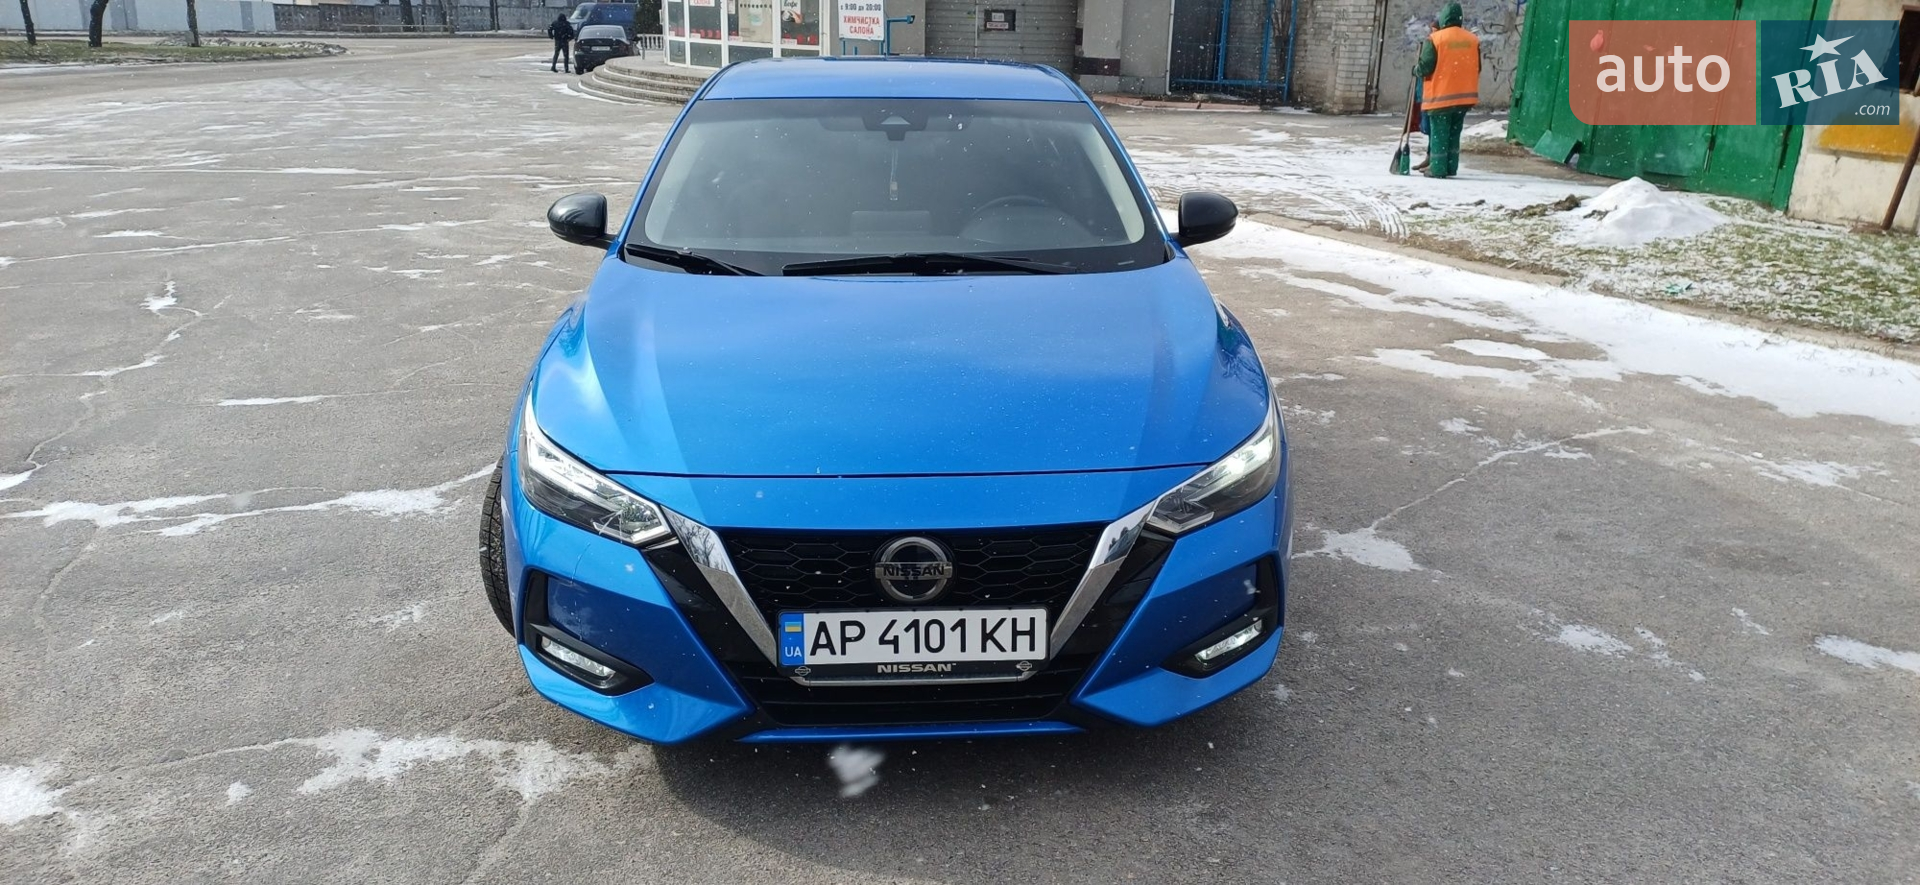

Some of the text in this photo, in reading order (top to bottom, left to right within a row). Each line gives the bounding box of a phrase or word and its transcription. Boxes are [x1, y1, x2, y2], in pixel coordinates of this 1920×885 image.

[866, 3, 882, 12] 20:00
[843, 16, 880, 26] ХИМЧИСТКА
[849, 26, 874, 35] САЛОНА
[883, 564, 945, 577] NISSAN
[810, 617, 1036, 657] AP 4101 KH
[785, 646, 802, 658] UA
